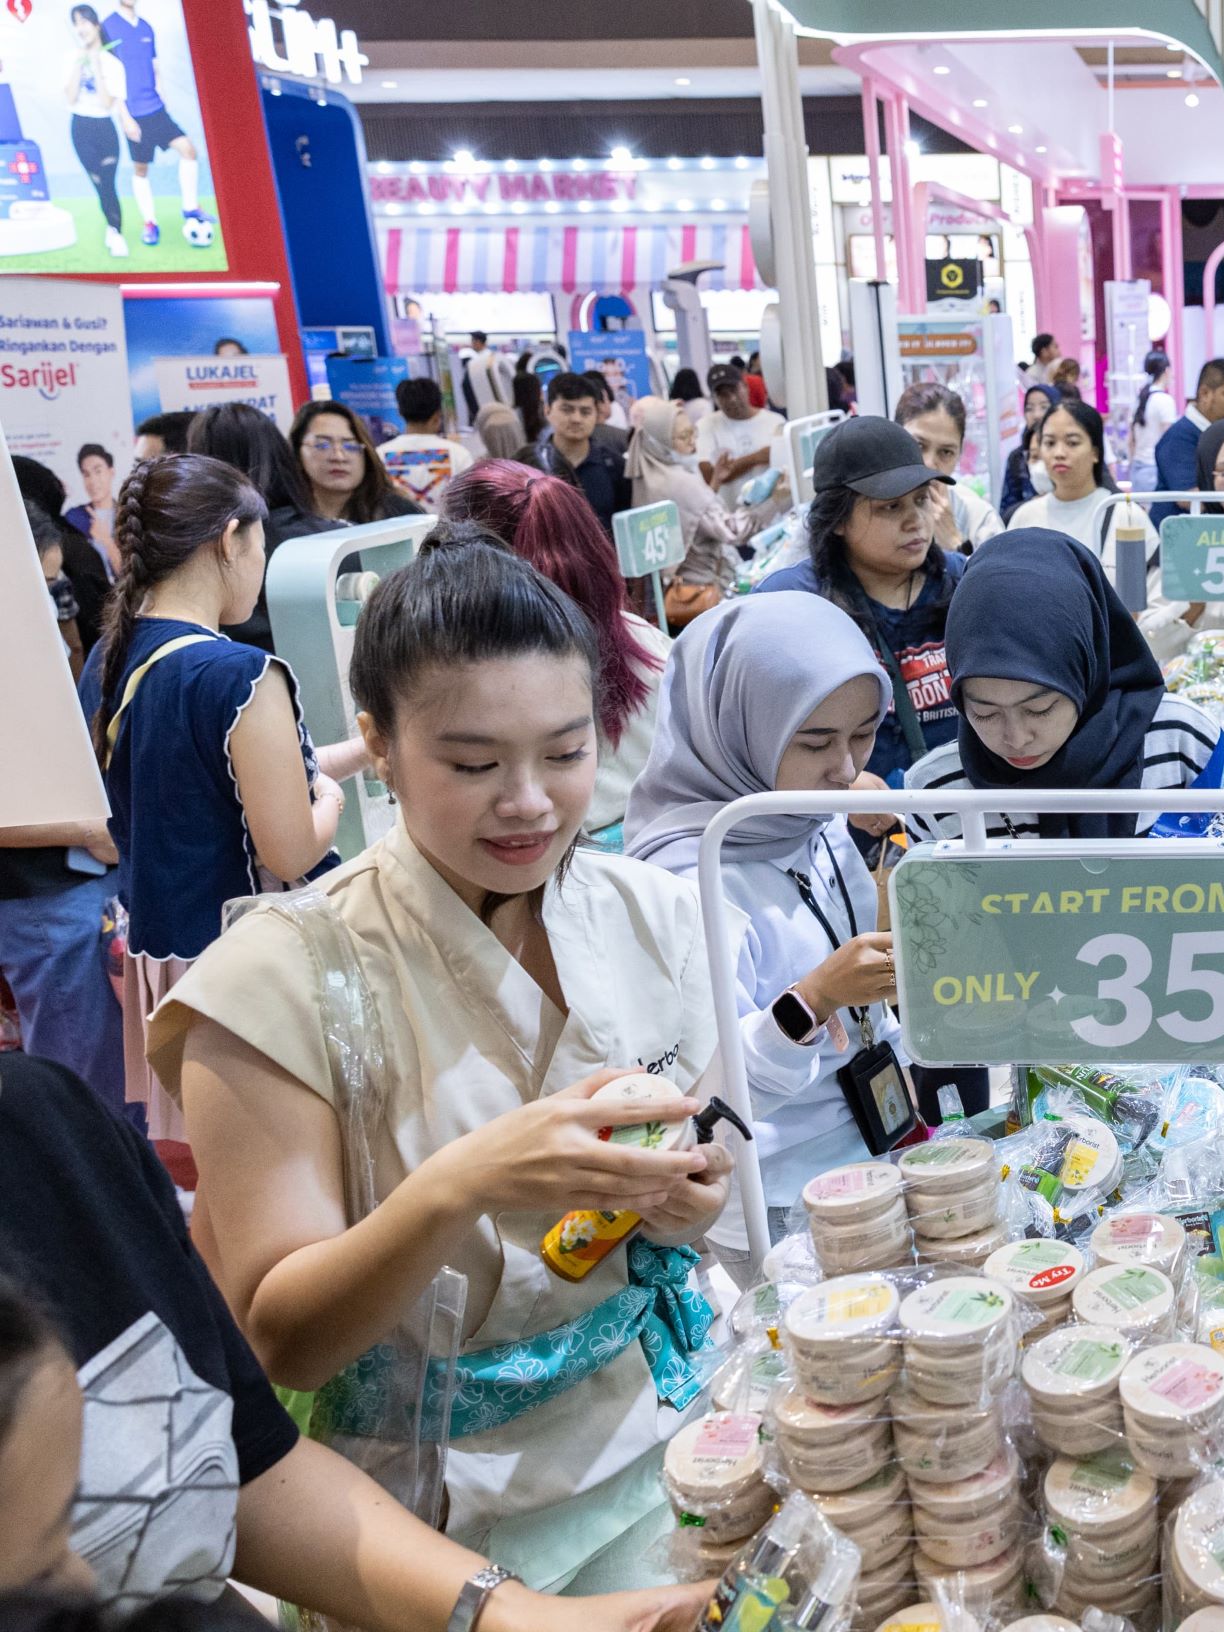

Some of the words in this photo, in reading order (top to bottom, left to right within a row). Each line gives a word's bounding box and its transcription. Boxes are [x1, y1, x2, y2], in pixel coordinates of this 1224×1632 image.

[499, 172, 638, 201] MARKET
[62, 316, 73, 330] &
[75, 316, 108, 331] Gusi?
[69, 340, 118, 356] Dengan
[1, 362, 77, 392] Sarijel
[186, 365, 258, 381] LUKAJEL
[932, 971, 1041, 1006] ONLY
[1078, 1137, 1100, 1150] rborist
[1031, 1275, 1052, 1288] Me
[1050, 1266, 1074, 1281] Try
